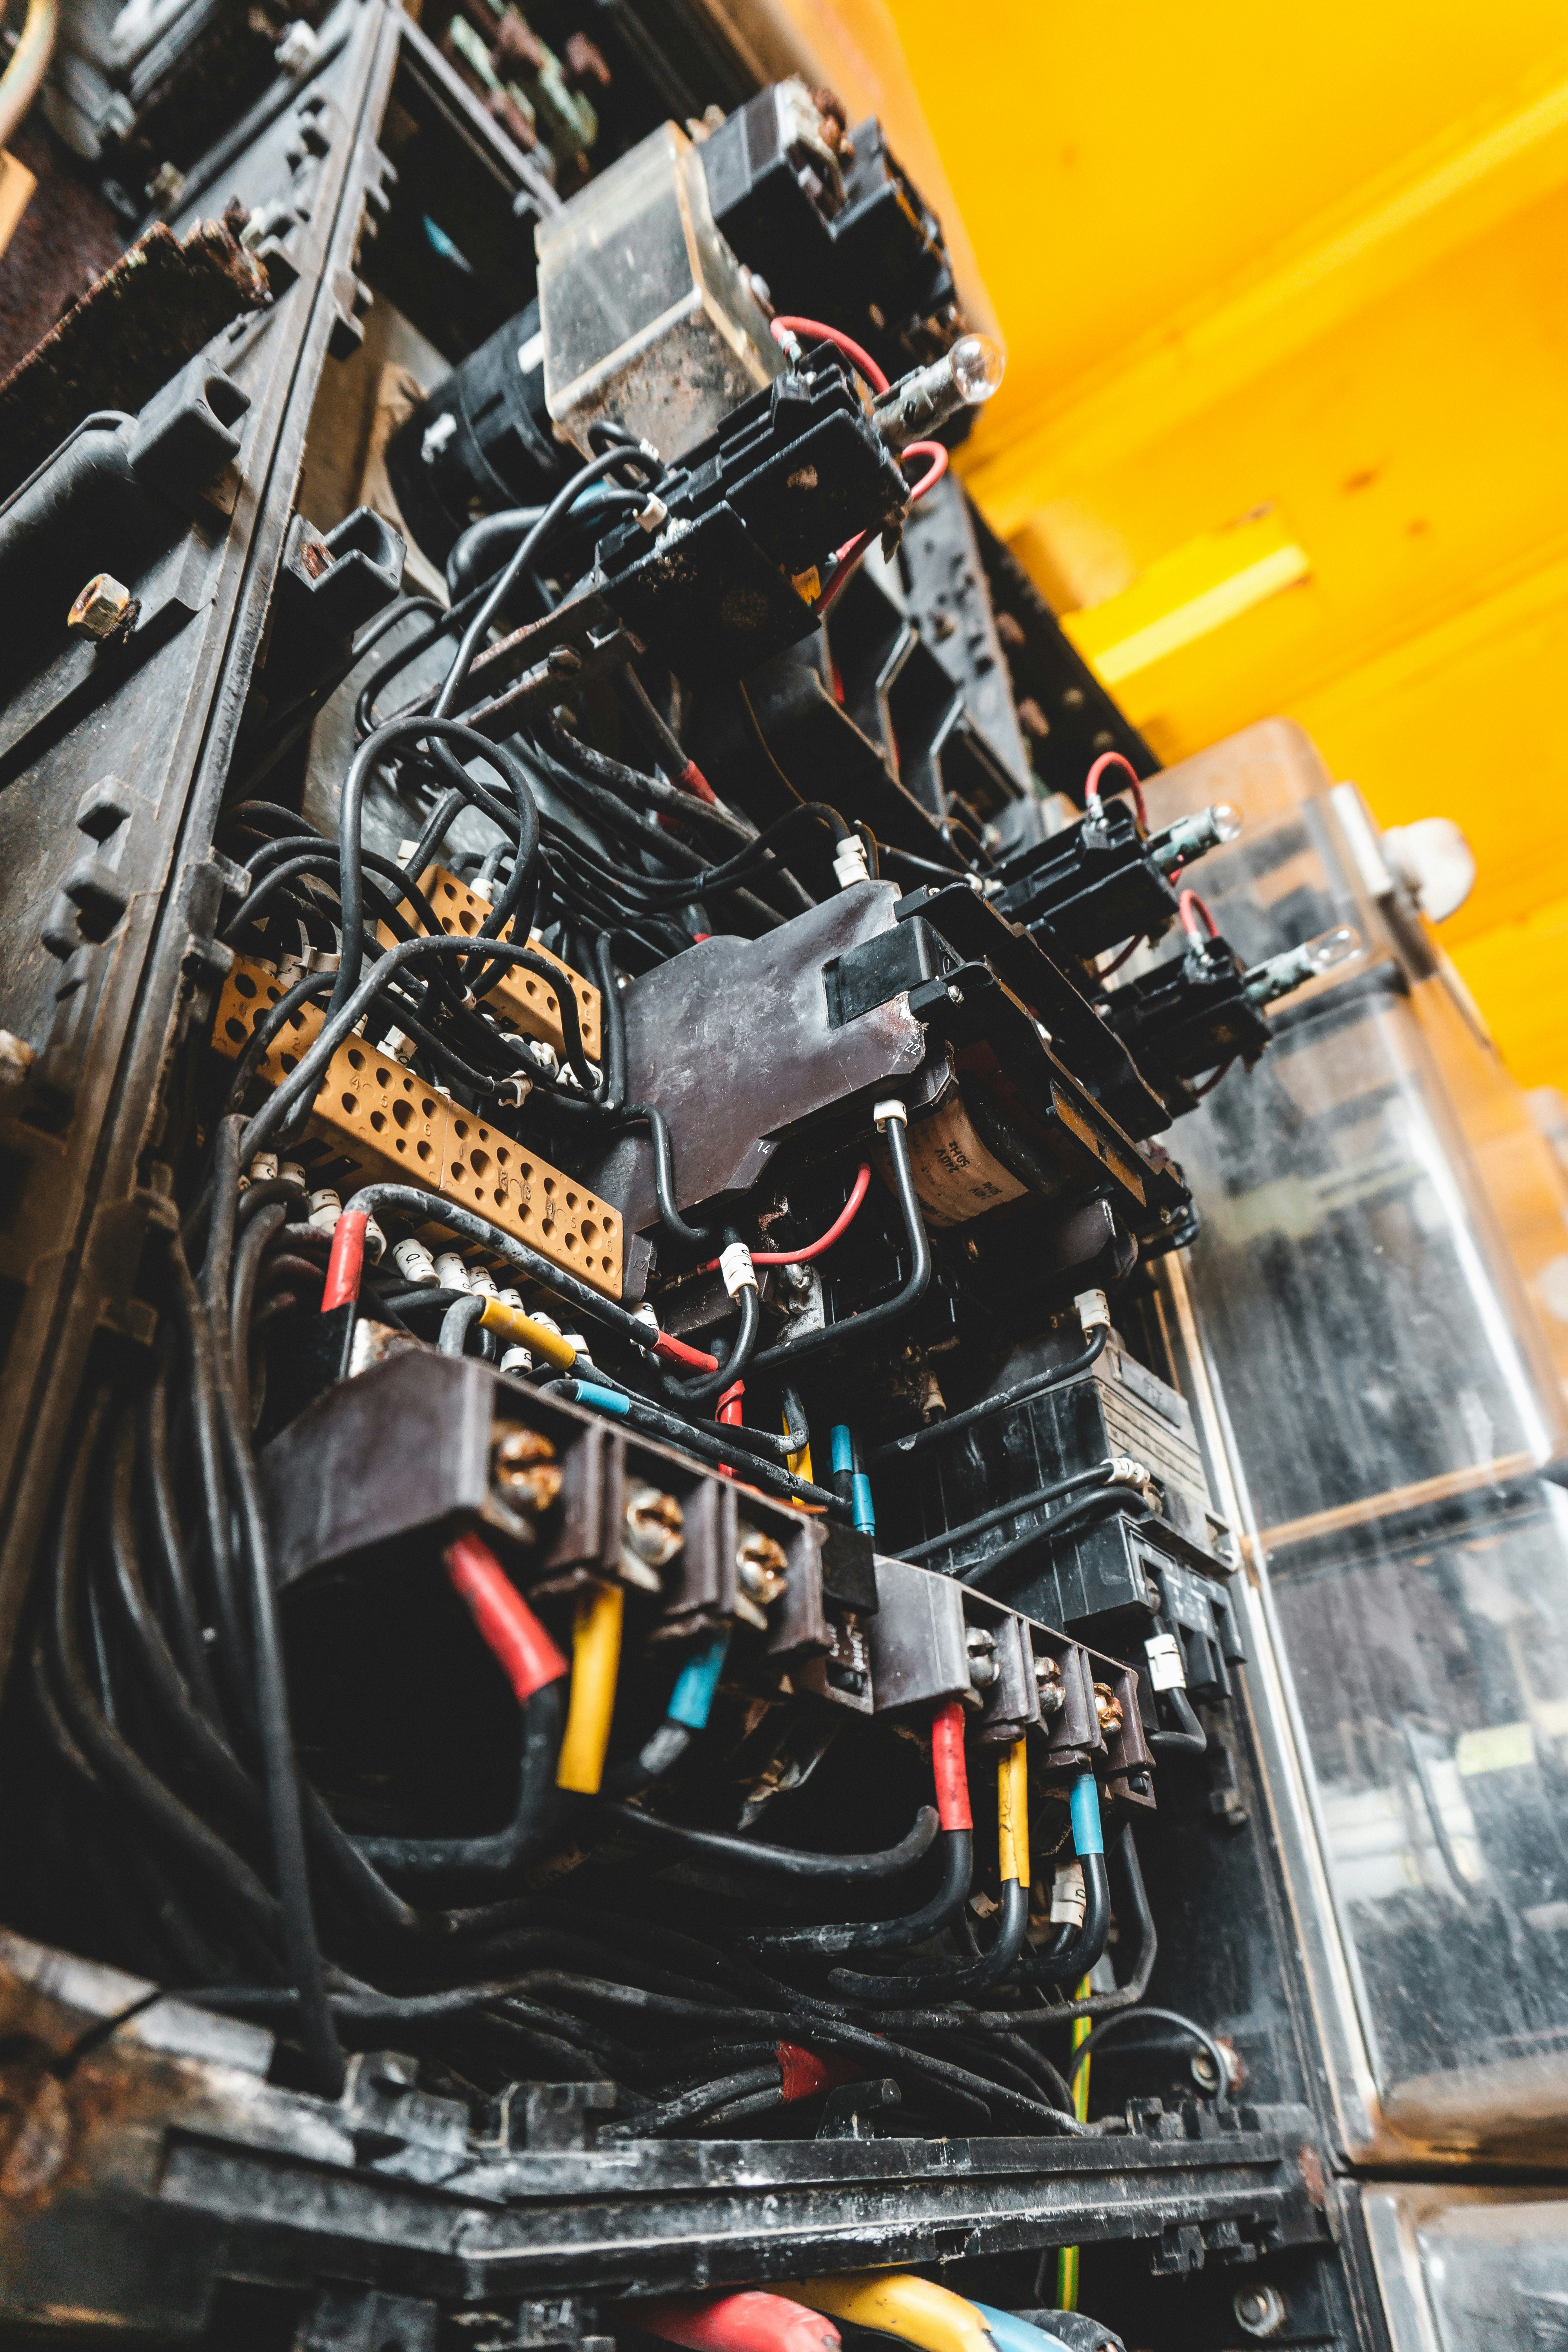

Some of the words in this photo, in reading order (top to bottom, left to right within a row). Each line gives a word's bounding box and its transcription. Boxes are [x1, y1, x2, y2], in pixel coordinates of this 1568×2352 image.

[905, 1041, 920, 1055] 22
[349, 1076, 360, 1090] 4
[379, 1093, 388, 1108] 5
[423, 1122, 431, 1136] 6
[757, 1142, 770, 1154] 14
[935, 1149, 959, 1173] 240V
[570, 1215, 577, 1229] 5
[606, 1240, 613, 1252] 6
[633, 1258, 646, 1271] A2
